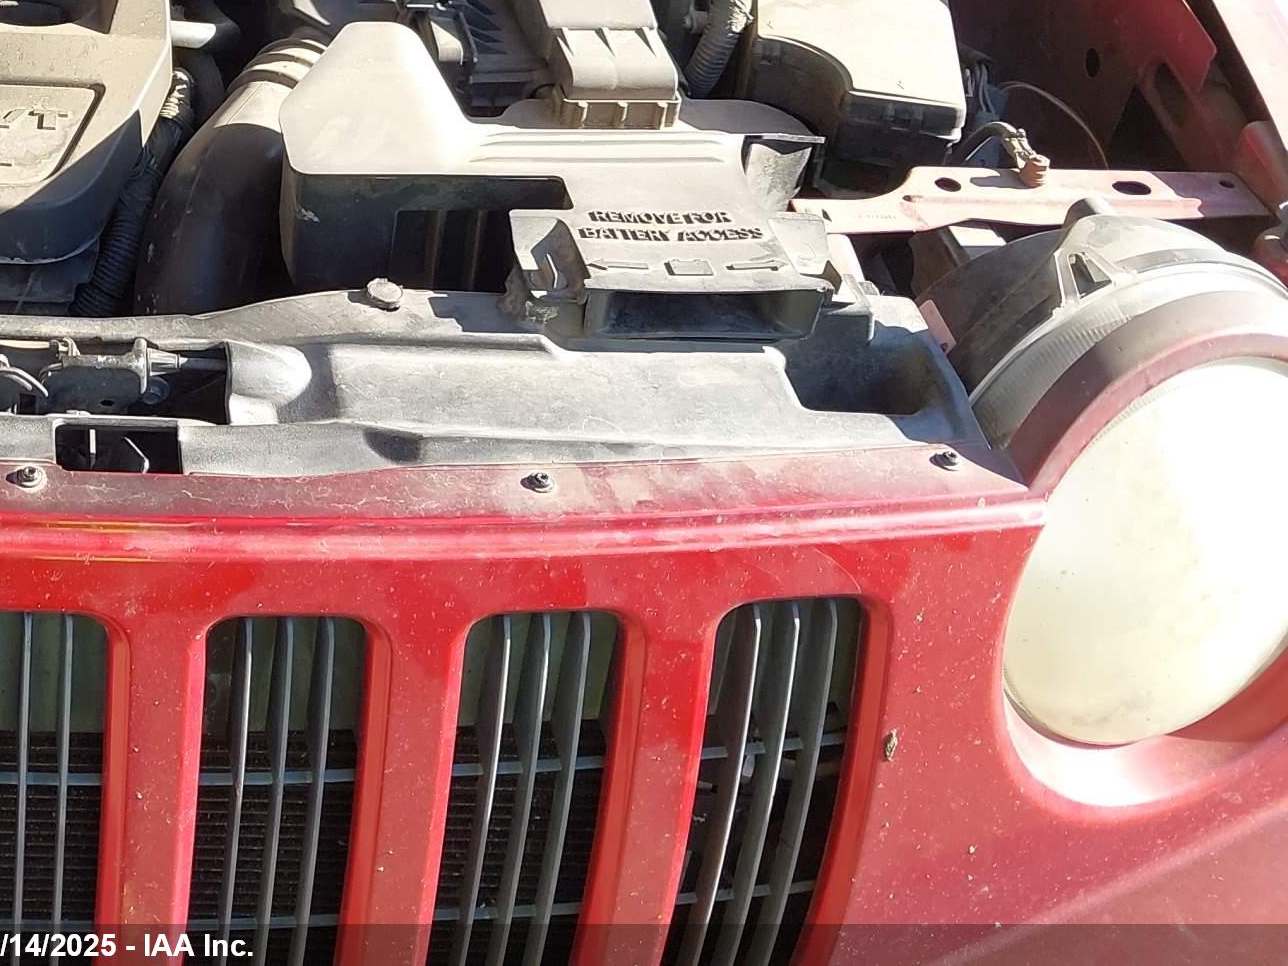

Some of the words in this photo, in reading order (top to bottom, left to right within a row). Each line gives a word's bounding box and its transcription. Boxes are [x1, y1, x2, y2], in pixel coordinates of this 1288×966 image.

[587, 210, 683, 225] REMOVE
[684, 211, 732, 224] FOR
[578, 228, 670, 242] BATTERY
[676, 227, 764, 242] ACCESS
